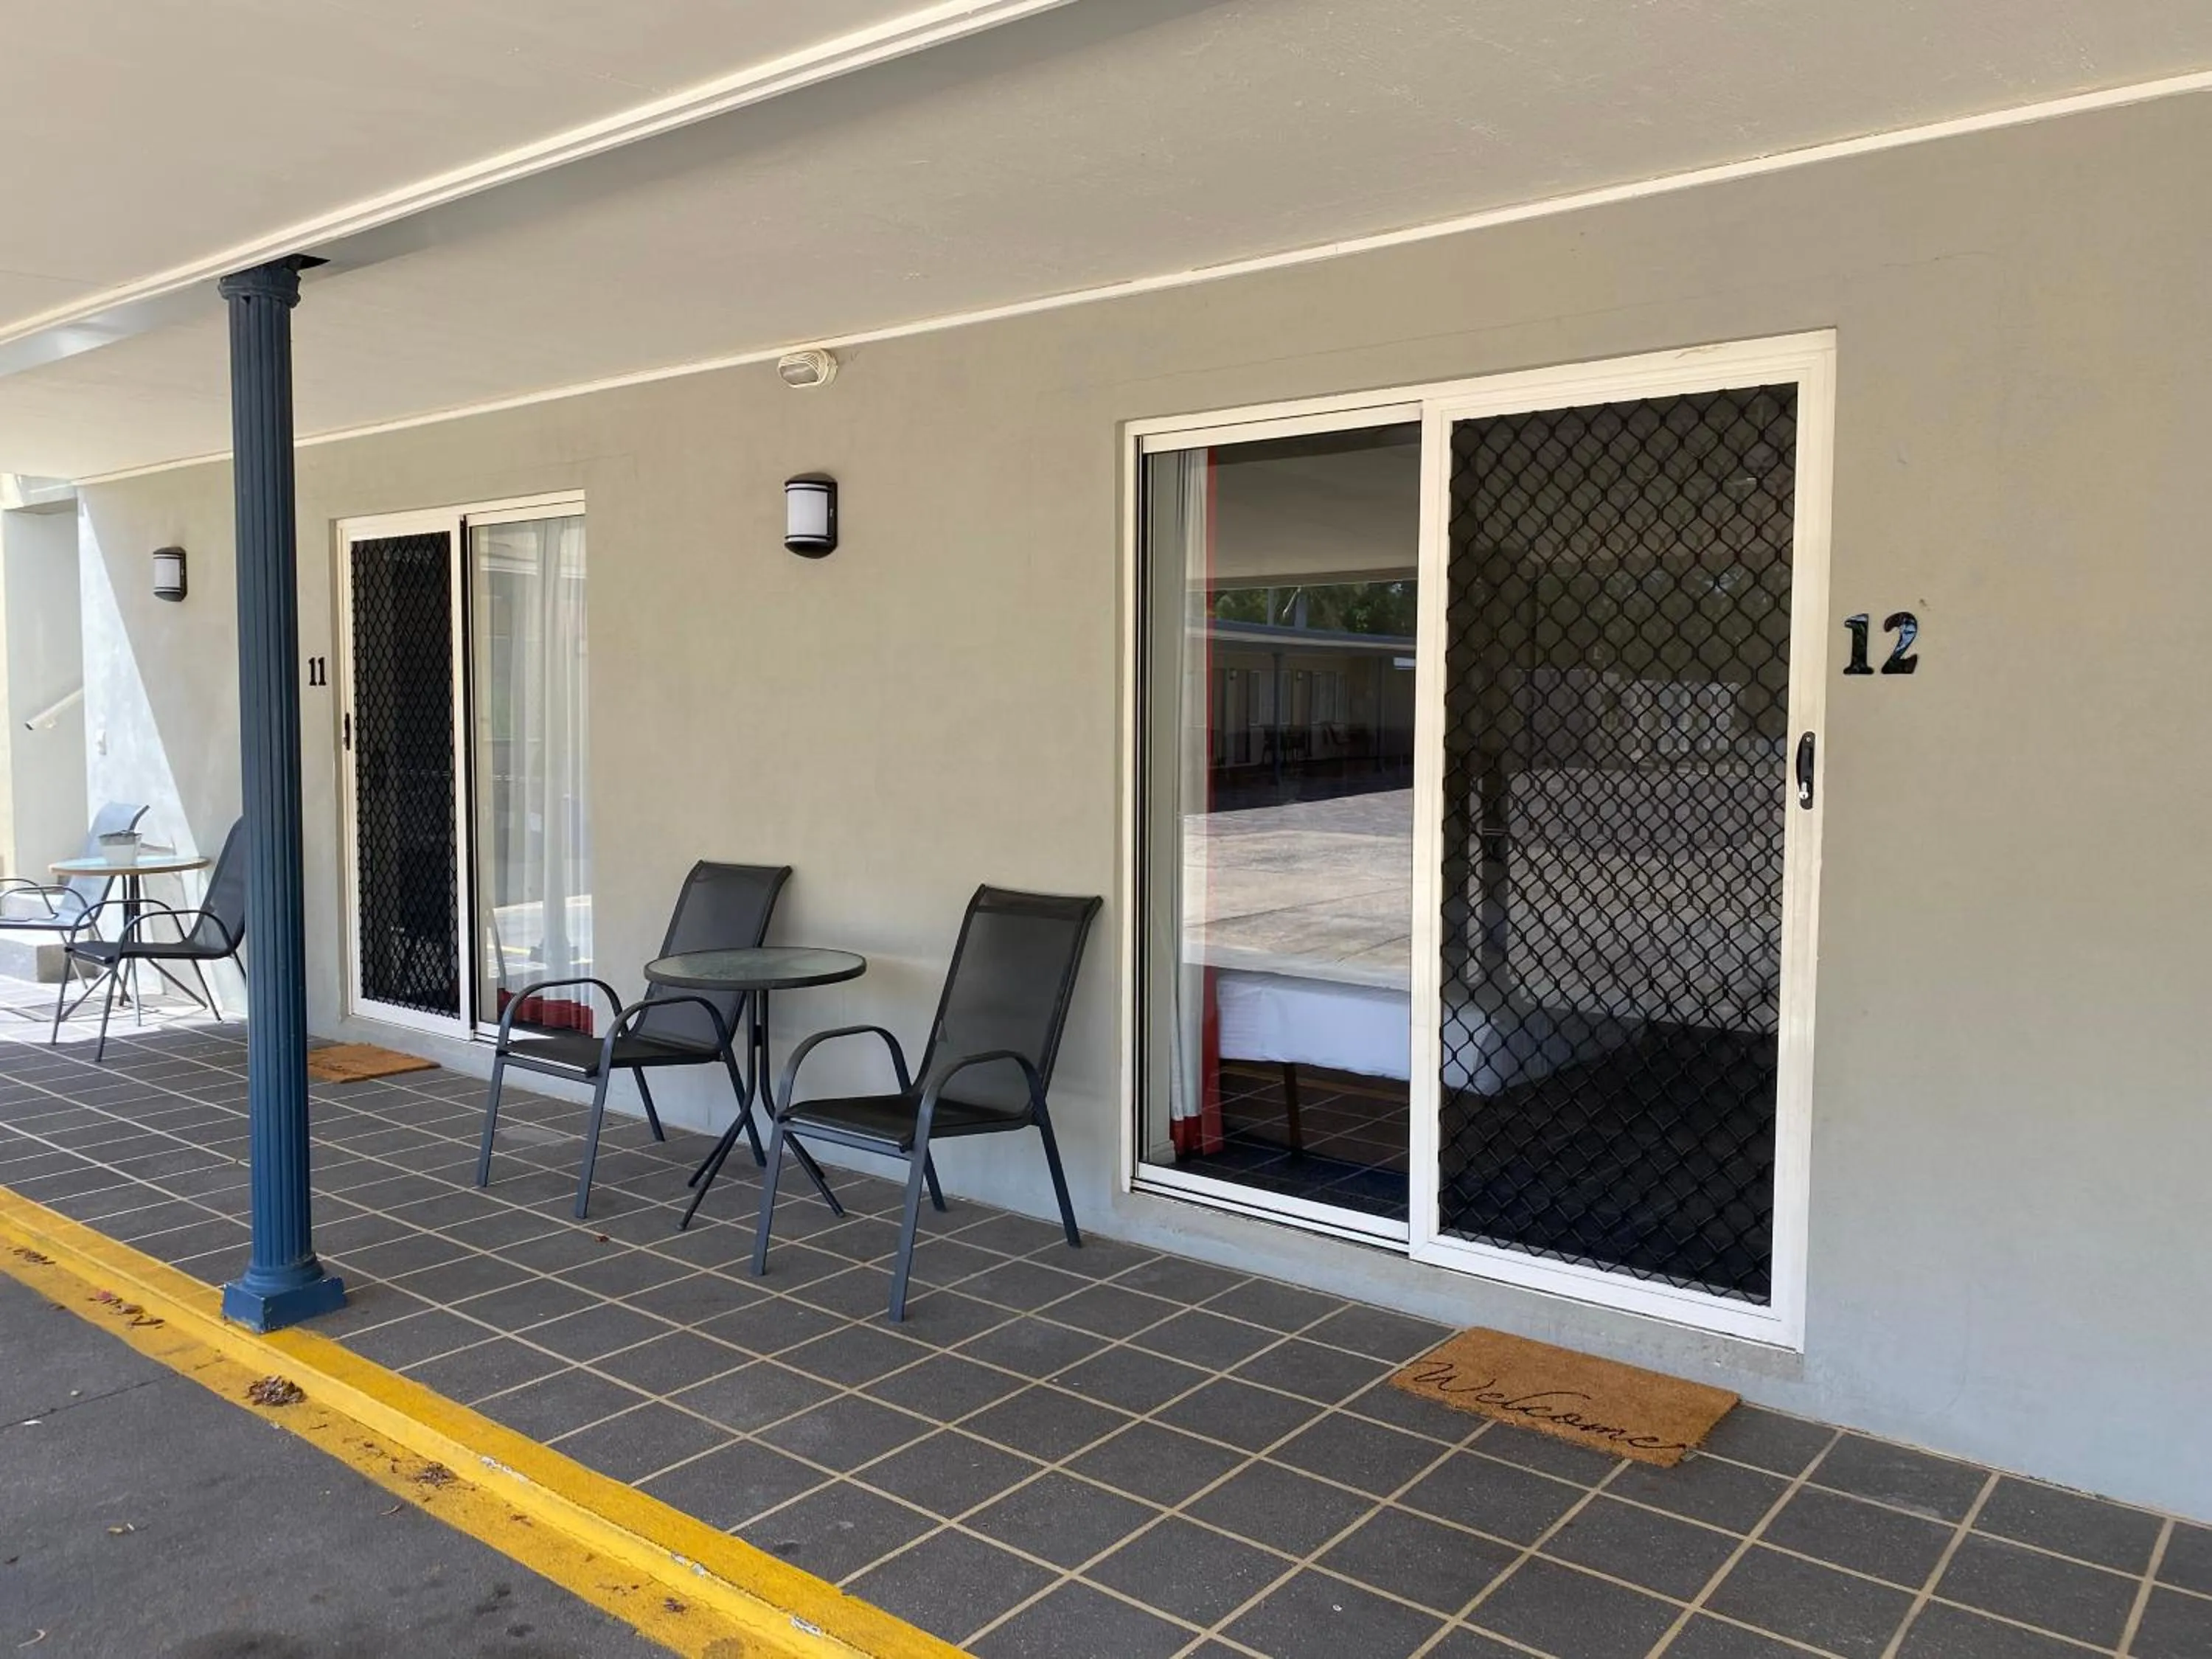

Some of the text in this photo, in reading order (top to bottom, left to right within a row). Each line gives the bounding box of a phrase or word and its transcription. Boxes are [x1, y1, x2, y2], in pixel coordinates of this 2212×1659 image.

[307, 657, 327, 686] 11
[1843, 611, 1919, 675] 12
[1414, 1361, 1686, 1449] Welcome
